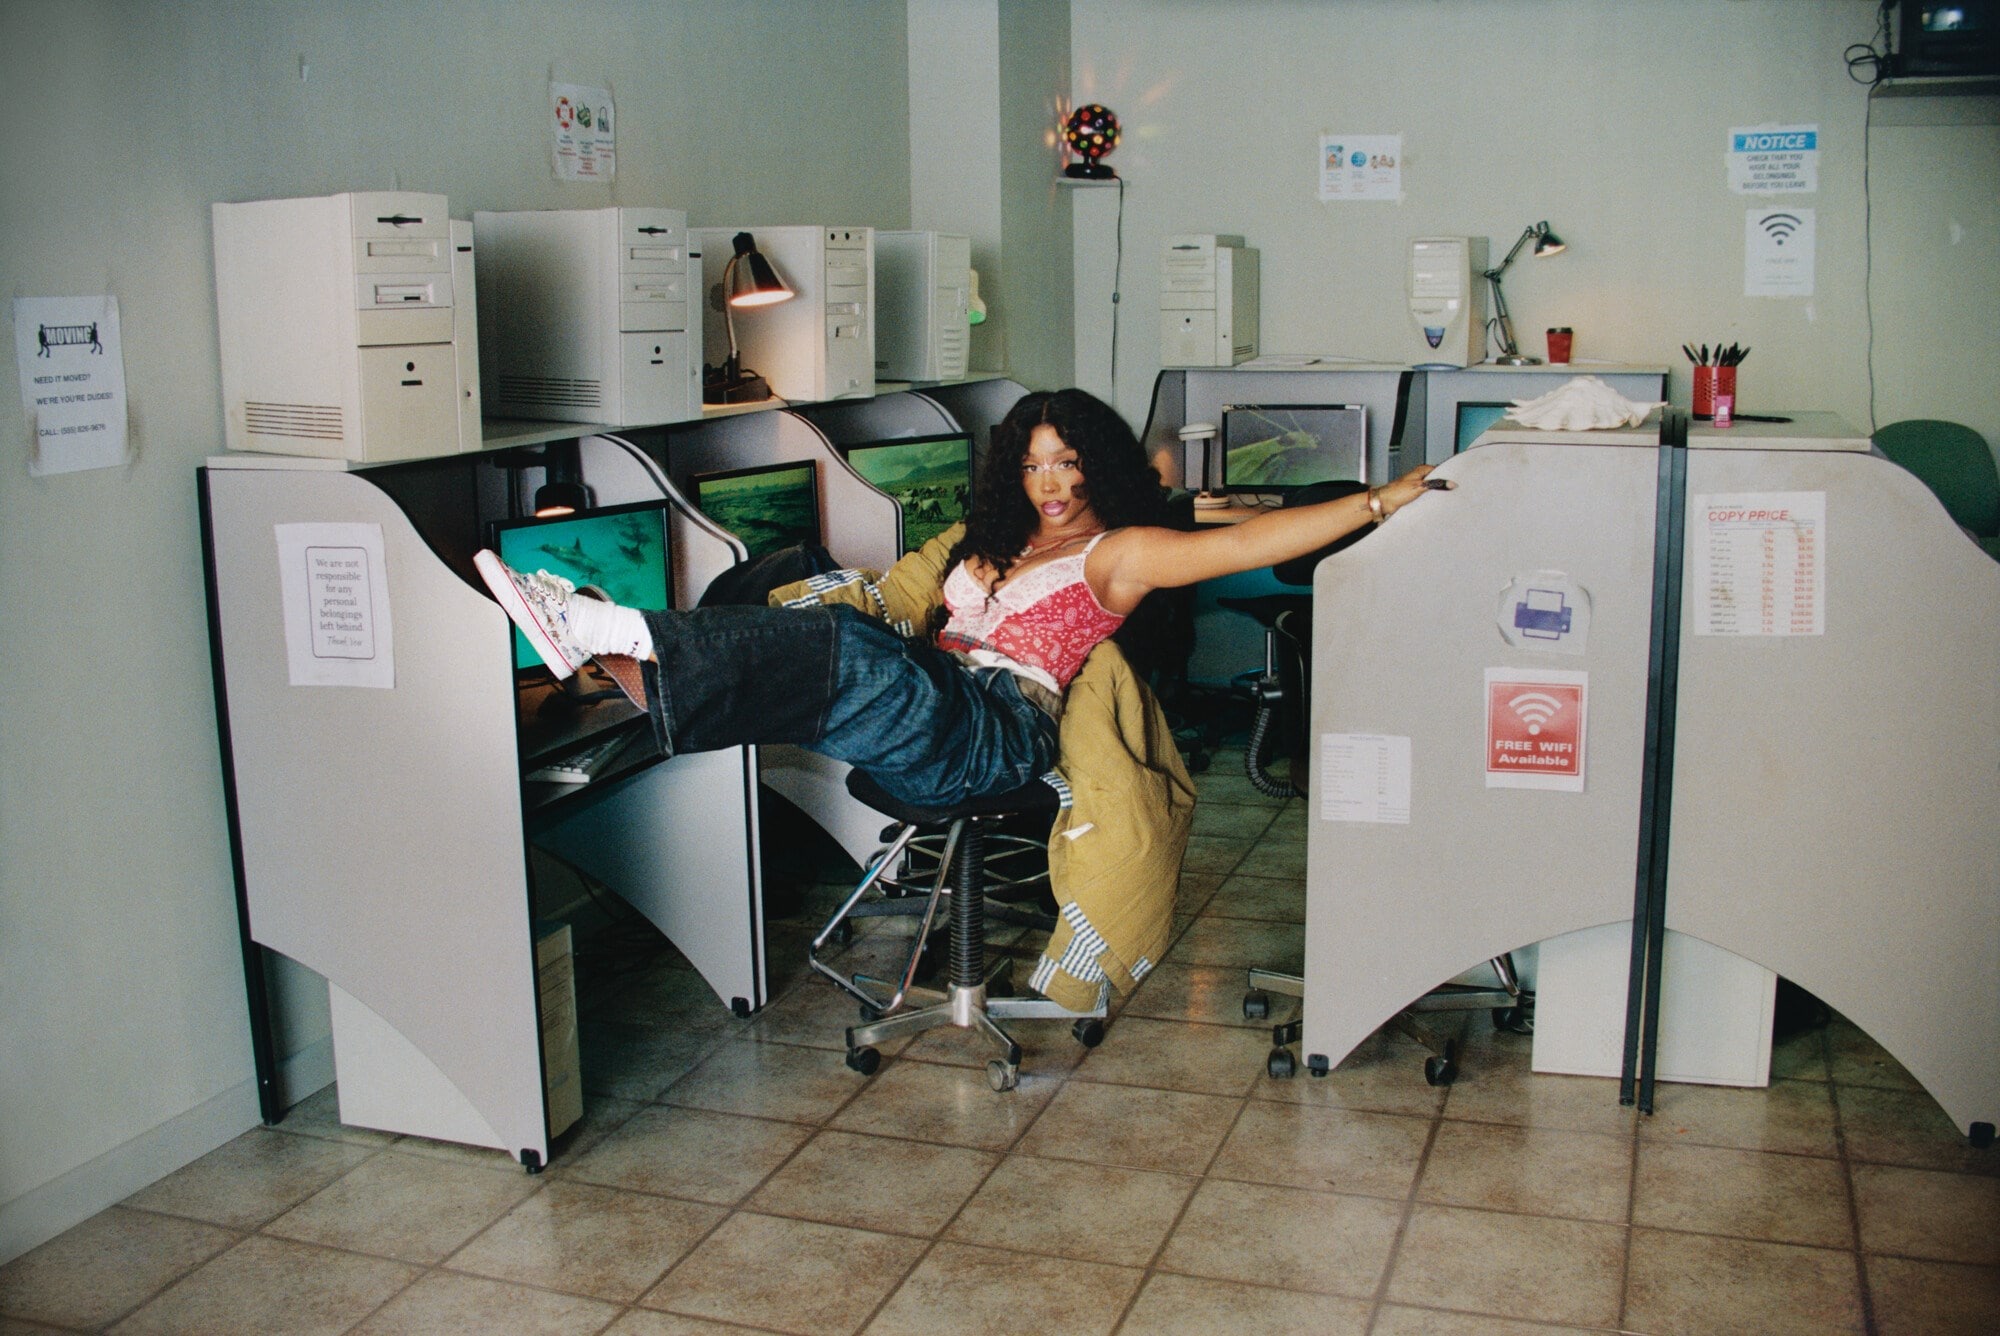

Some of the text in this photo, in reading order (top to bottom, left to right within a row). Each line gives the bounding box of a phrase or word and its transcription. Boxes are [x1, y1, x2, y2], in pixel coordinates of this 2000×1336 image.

[1745, 134, 1807, 150] NOTICE
[1790, 152, 1803, 161] YOU
[45, 327, 91, 344] MOVING
[34, 373, 91, 384] NEED IT MOVED?
[36, 396, 59, 405] WE'RE
[60, 394, 86, 404] YOU'RE
[1708, 510, 1789, 522] COPY PRICE
[315, 558, 360, 568] We are not
[316, 572, 361, 582] responsible
[326, 584, 352, 596] for any
[323, 597, 358, 608] personal
[320, 609, 363, 621] belongings
[320, 621, 334, 630] left
[1495, 740, 1574, 753] FREE WIFI
[1498, 753, 1569, 766] Available
